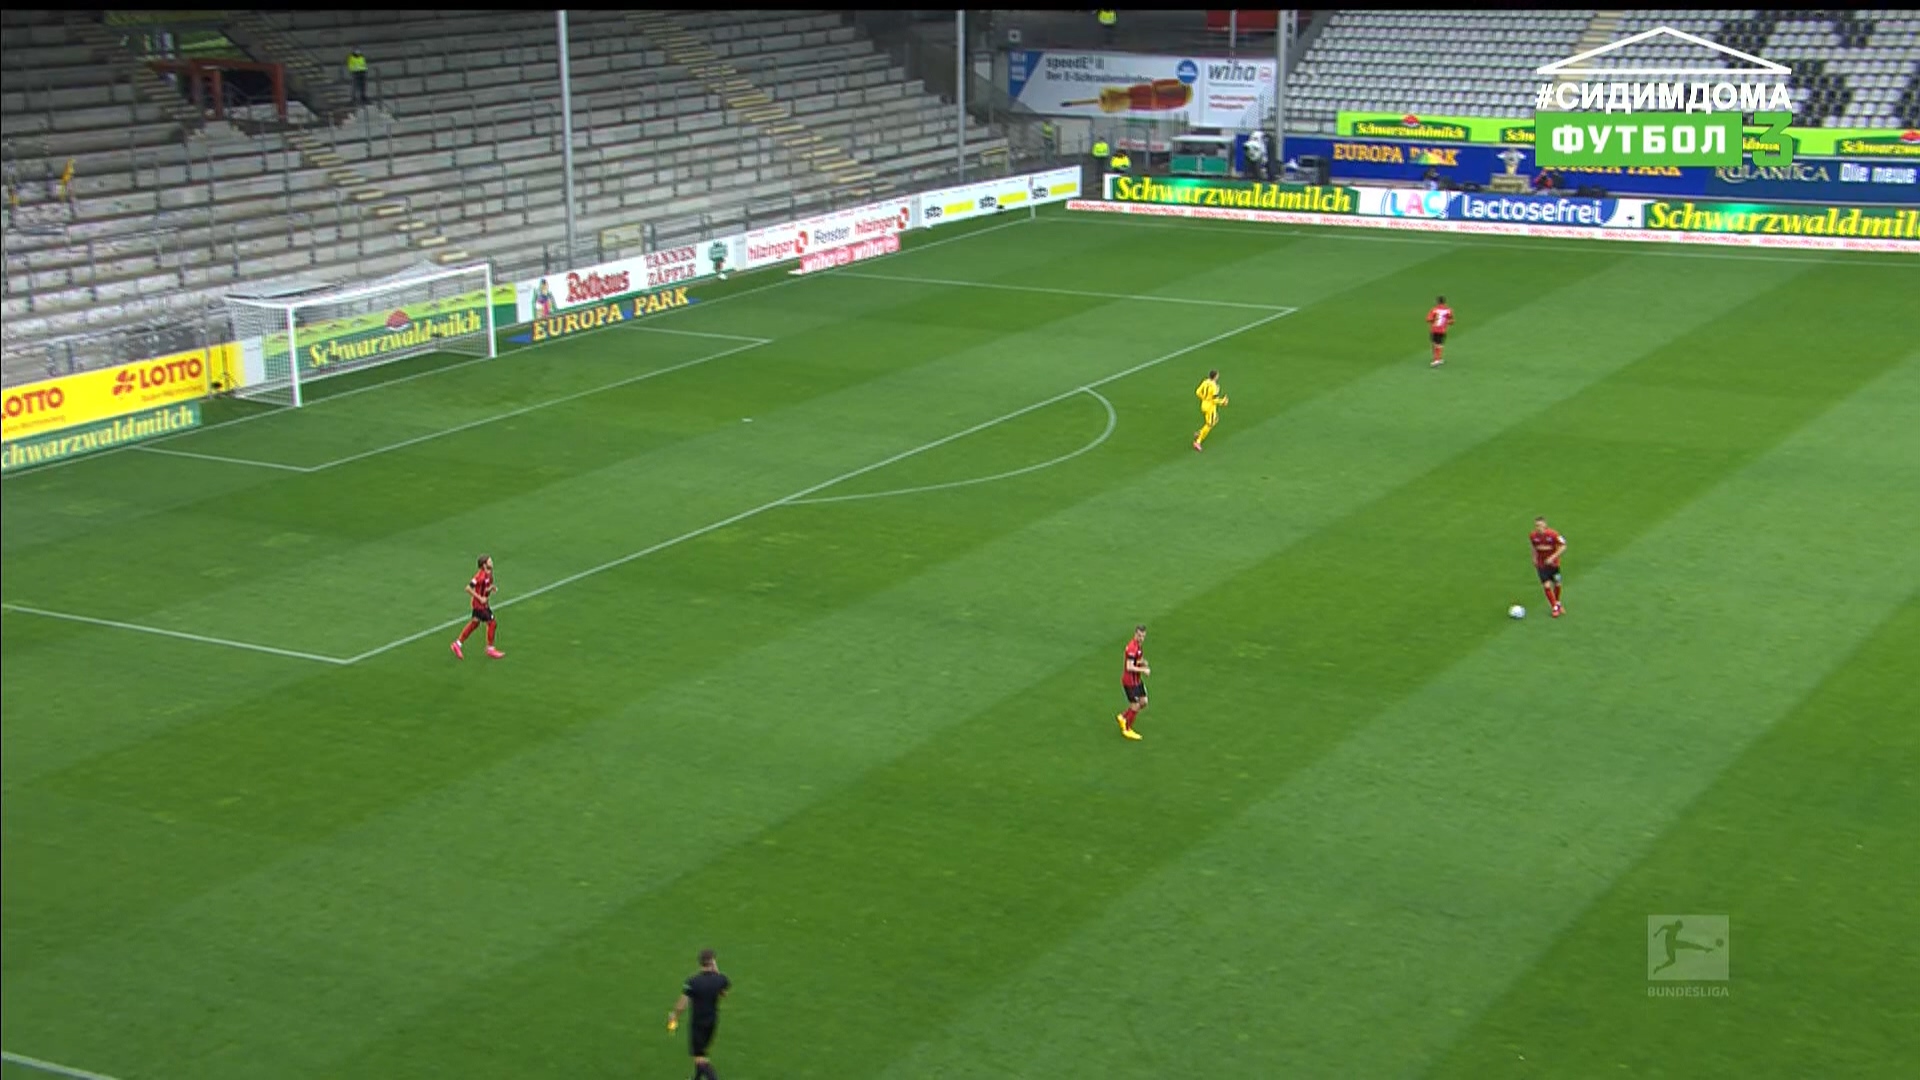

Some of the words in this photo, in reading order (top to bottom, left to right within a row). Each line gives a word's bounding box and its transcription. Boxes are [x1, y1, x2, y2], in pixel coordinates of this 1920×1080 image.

[1208, 58, 1256, 81] wiha
[1333, 143, 1404, 164] EUROPA
[1115, 176, 1351, 212] Schwarzwaldmilch
[1391, 190, 1442, 216] LAC
[1462, 193, 1602, 224] lactosefrei
[645, 246, 697, 268] TANNEN
[748, 239, 795, 260] hilzinger
[814, 226, 851, 245] Fenster
[566, 270, 630, 303] Rothaus
[648, 263, 697, 287] ZÄPFLE
[532, 303, 625, 342] EUROPA
[633, 287, 689, 316] PARK
[309, 309, 482, 368] Schwarzwaldmilch
[139, 358, 203, 389] LOTTO
[2, 387, 64, 420] OTTO
